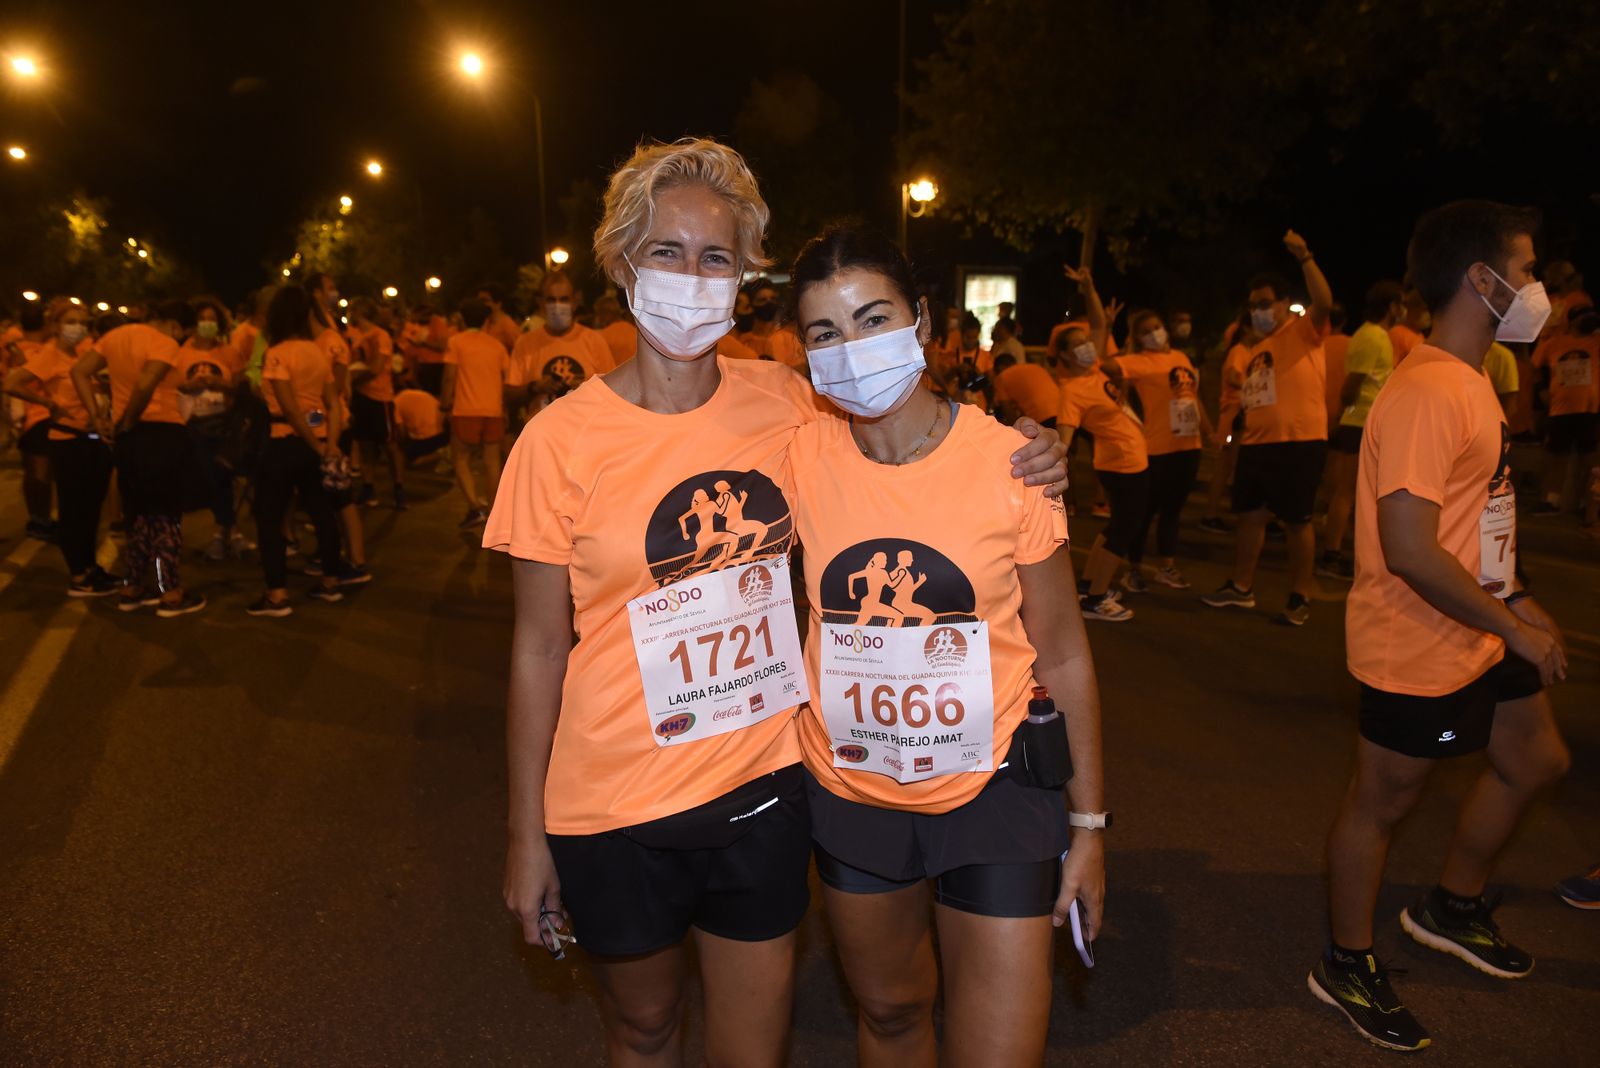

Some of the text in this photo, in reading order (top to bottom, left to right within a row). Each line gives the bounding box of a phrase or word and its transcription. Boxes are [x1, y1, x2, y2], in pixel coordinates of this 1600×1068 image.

[689, 619, 723, 633] NOCTURNA
[734, 604, 769, 621] GUADALQUIVIR
[669, 615, 774, 684] 1721
[934, 655, 965, 663] NOCTURNA
[668, 689, 706, 706] LAURA
[708, 674, 753, 697] FAJARDO
[754, 661, 787, 682] FLORES
[841, 670, 864, 678] CARRERA
[865, 673, 897, 681] NOCTURNA
[911, 671, 958, 681] GUADALQUIVIR
[844, 681, 965, 728] 1666
[850, 729, 888, 743] ESTHER
[890, 733, 931, 748] PAREJO
[933, 733, 963, 746] AMAT
[961, 750, 980, 759] ABC
